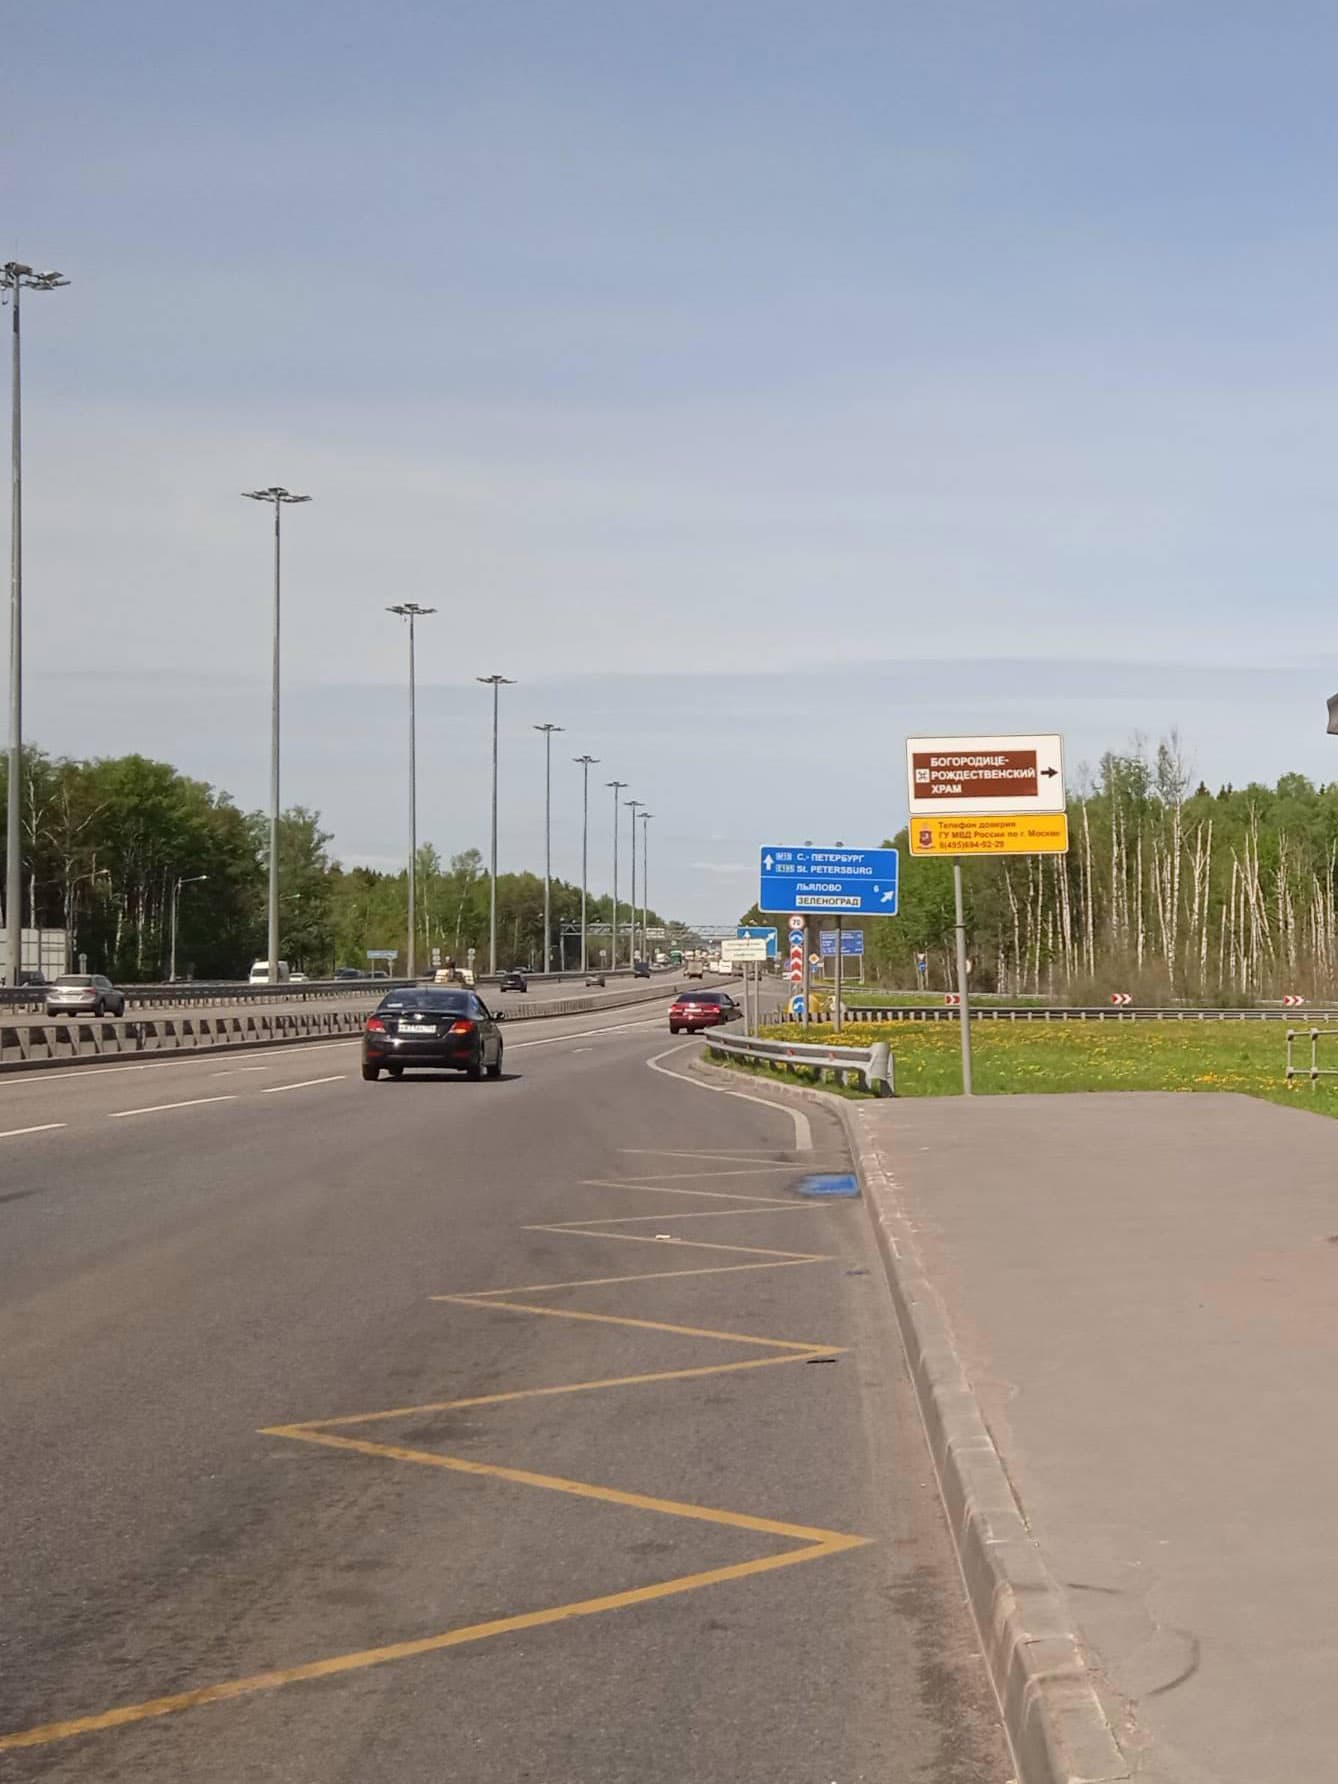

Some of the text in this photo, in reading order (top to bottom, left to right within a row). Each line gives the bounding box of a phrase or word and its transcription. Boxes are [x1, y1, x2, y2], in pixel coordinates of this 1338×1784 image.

[930, 755, 1009, 767] БОГОРОДИЦЕ-
[931, 767, 1036, 781] РОЖДЕСТВЕНСКИЙ
[931, 784, 962, 794] ХРАМ
[938, 821, 977, 830] Телефон
[810, 865, 873, 875] PETERSBURG
[797, 896, 859, 906] ЗЕЛЕНОГРАД
